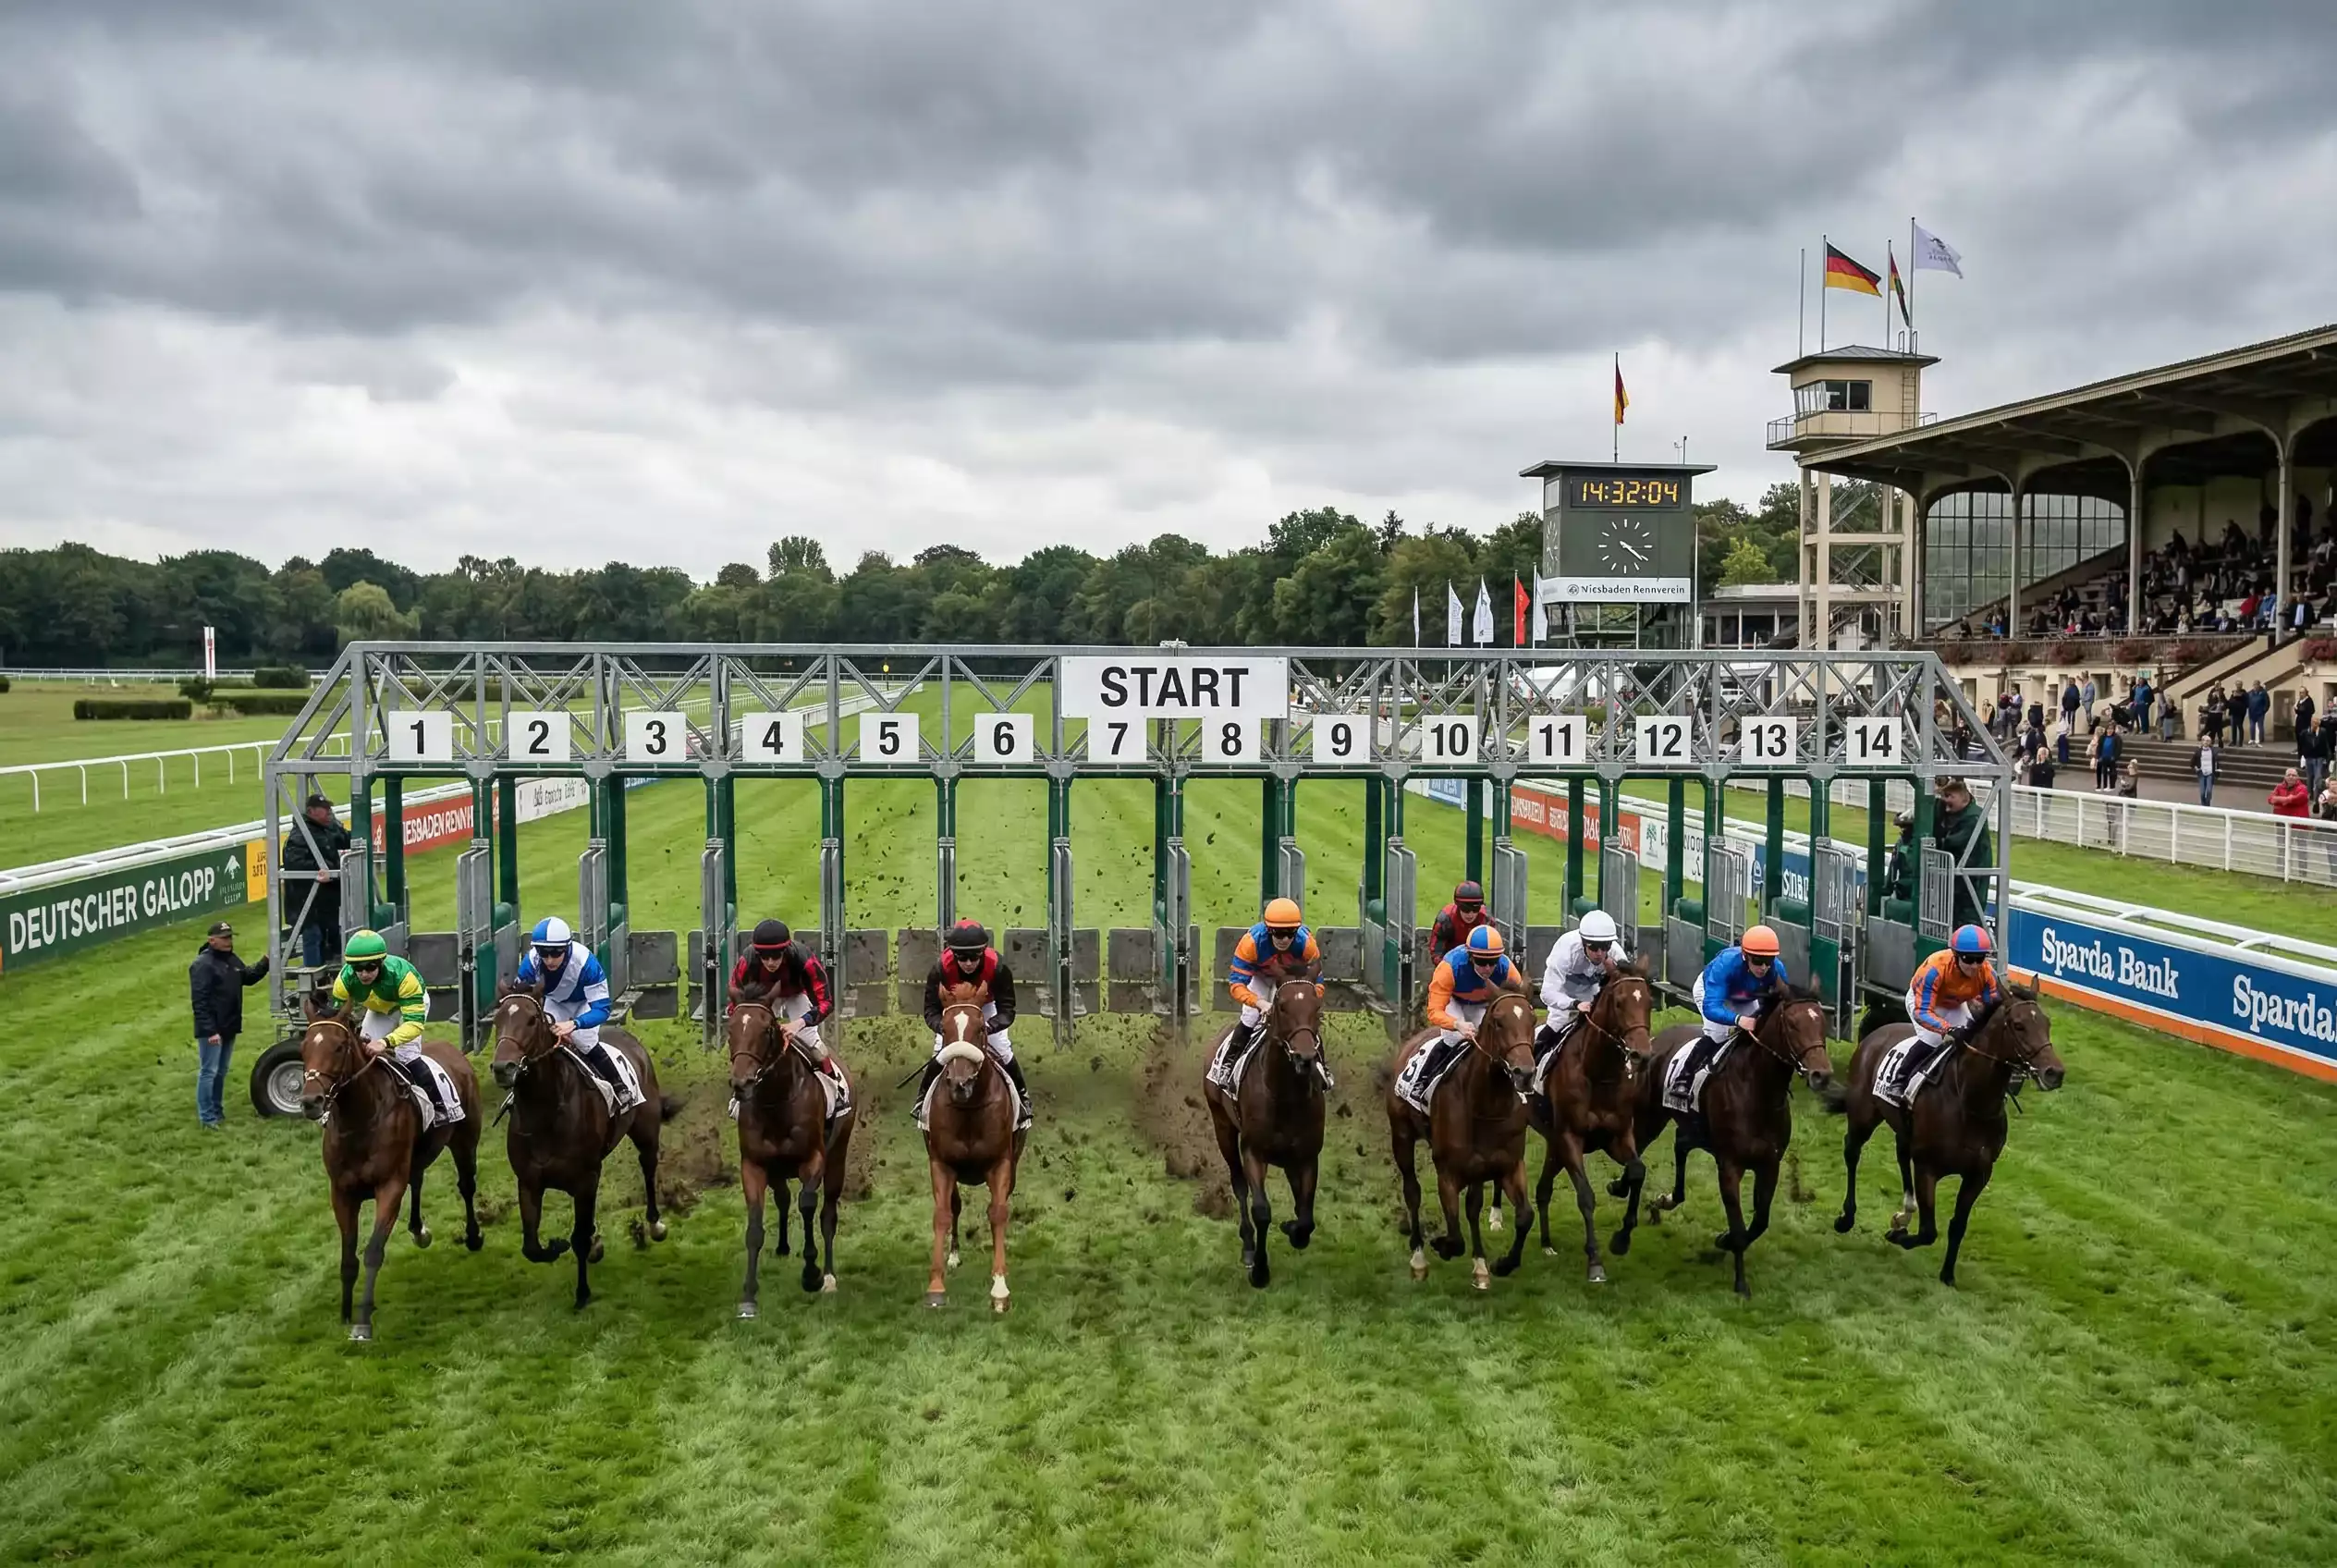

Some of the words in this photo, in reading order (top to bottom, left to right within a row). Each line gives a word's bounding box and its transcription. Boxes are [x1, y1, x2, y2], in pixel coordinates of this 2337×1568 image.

[1582, 481, 1678, 504] 14:32:04
[1633, 584, 1685, 594] Rennverein
[1101, 667, 1249, 707] START
[410, 719, 424, 754] 1
[528, 720, 550, 754] 2
[645, 720, 667, 755] 3
[762, 720, 784, 755] 4
[879, 721, 899, 755] 5
[993, 721, 1015, 755] 6
[1107, 722, 1129, 755] 7
[1220, 722, 1242, 756] 8
[1331, 723, 1352, 756] 9
[1430, 723, 1469, 756] 10
[1539, 723, 1572, 756] 11
[1644, 724, 1682, 757] 12
[1750, 724, 1787, 757] 13
[1854, 724, 1892, 758] 14
[9, 885, 138, 955] DEUTSCHER
[142, 866, 215, 917] GALOPP
[2042, 927, 2114, 980] Sparda
[2117, 946, 2179, 999] Bank
[2233, 974, 2335, 1043] Sparda
